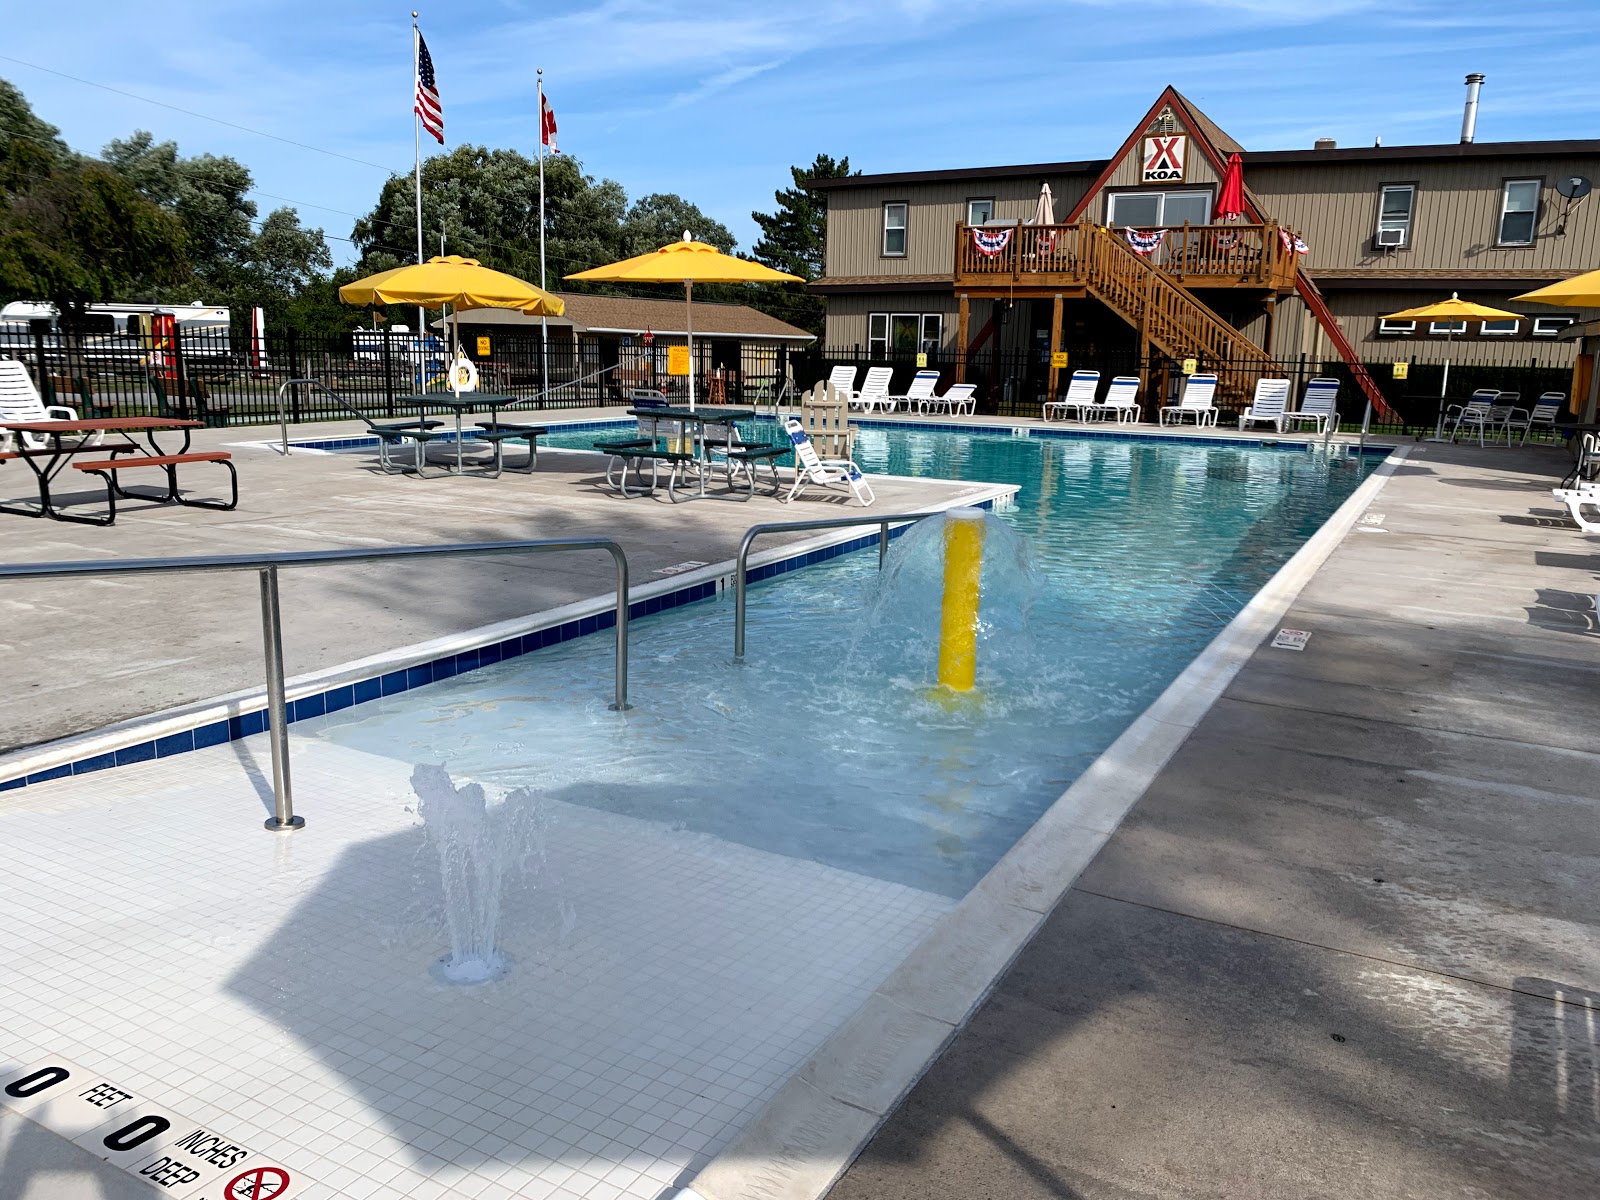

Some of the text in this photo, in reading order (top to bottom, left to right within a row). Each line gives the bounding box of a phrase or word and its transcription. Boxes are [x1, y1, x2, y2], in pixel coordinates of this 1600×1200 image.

[1145, 171, 1182, 180] KOA
[720, 577, 725, 590] 1
[79, 1083, 134, 1110] FEET
[174, 1129, 248, 1169] INCHES
[139, 1156, 200, 1188] DEEP
